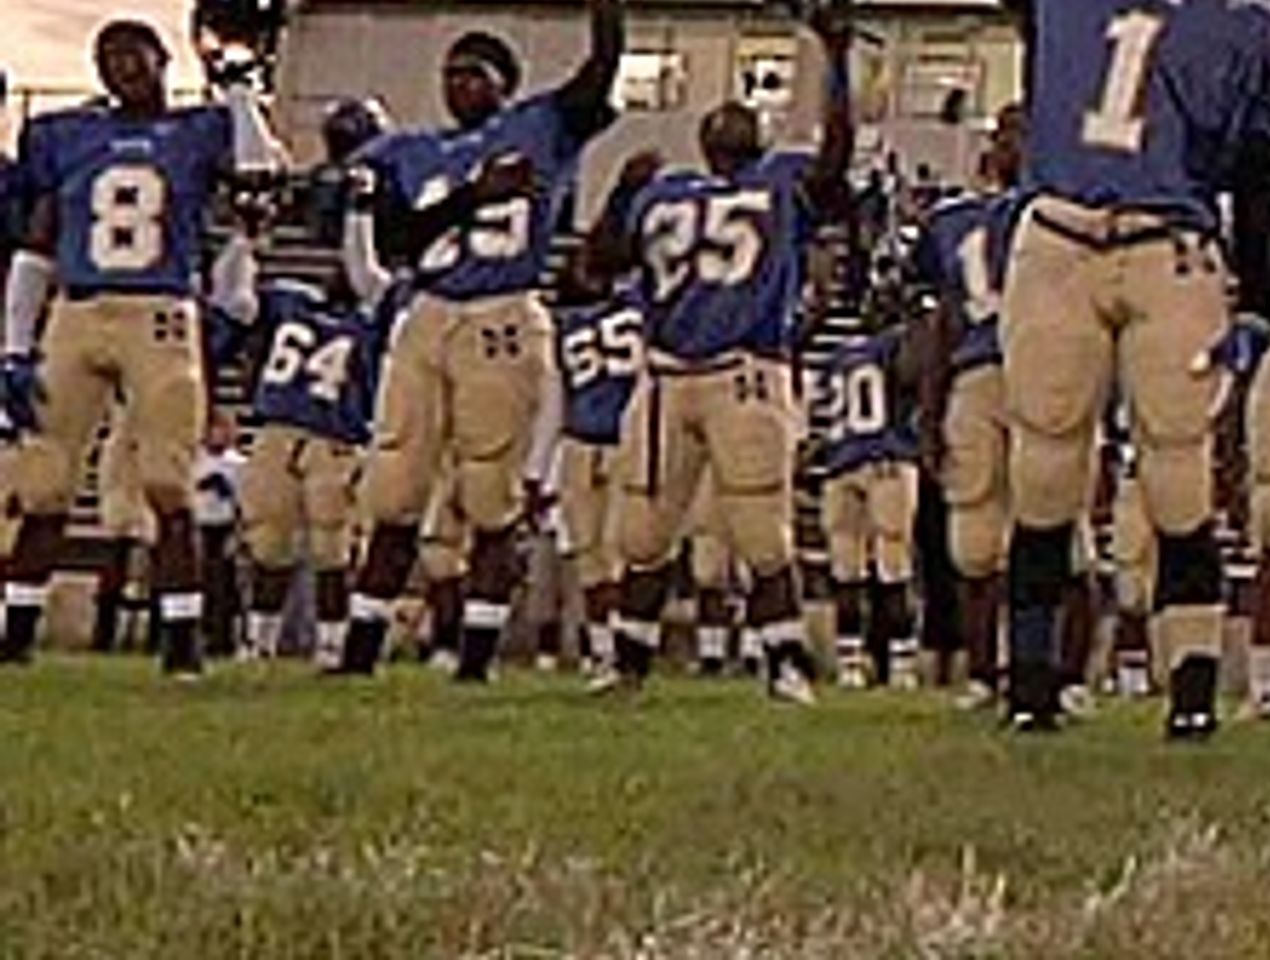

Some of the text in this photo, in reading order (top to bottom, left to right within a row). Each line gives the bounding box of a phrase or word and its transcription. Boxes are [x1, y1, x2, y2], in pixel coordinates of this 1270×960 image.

[1082, 10, 1165, 153] 1
[89, 164, 165, 270] 8
[642, 191, 771, 301] 25
[262, 323, 353, 400] 64
